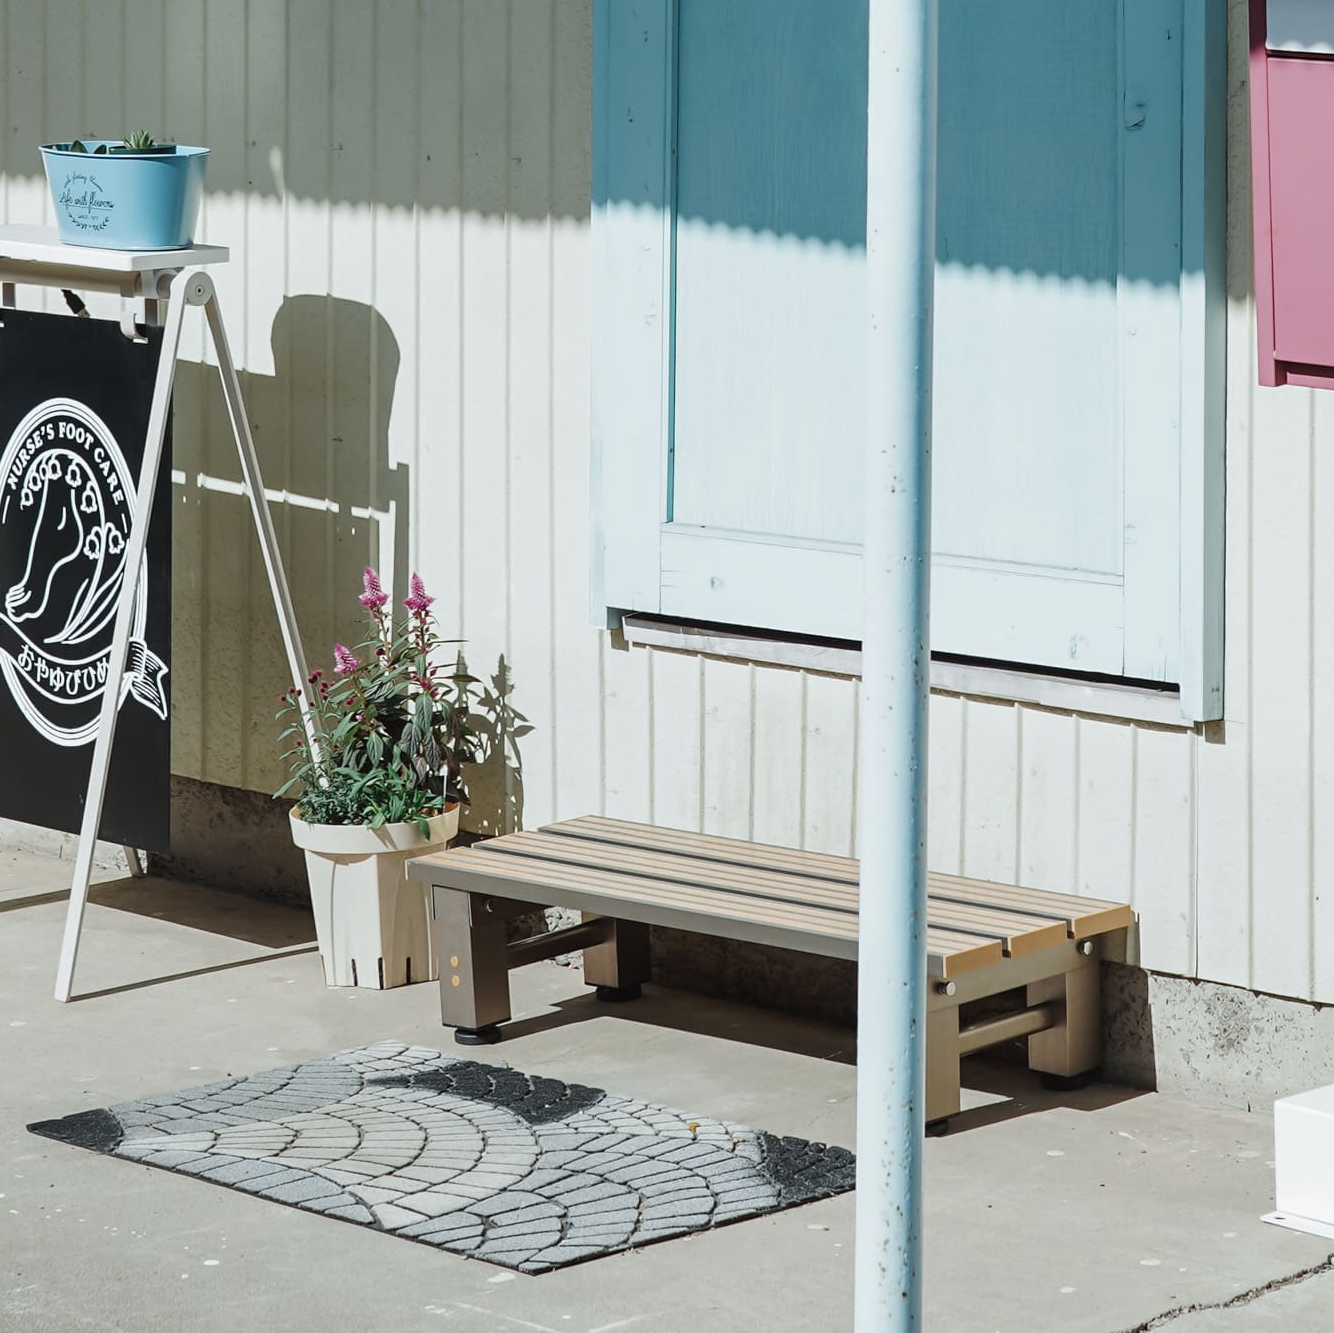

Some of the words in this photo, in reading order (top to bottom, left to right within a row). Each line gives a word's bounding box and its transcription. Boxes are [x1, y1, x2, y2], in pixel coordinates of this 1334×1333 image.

[6, 422, 55, 491] NURSE'S
[58, 421, 95, 451] FOOT
[93, 446, 127, 507] CARE
[17, 644, 109, 696] おやゆびひめ
